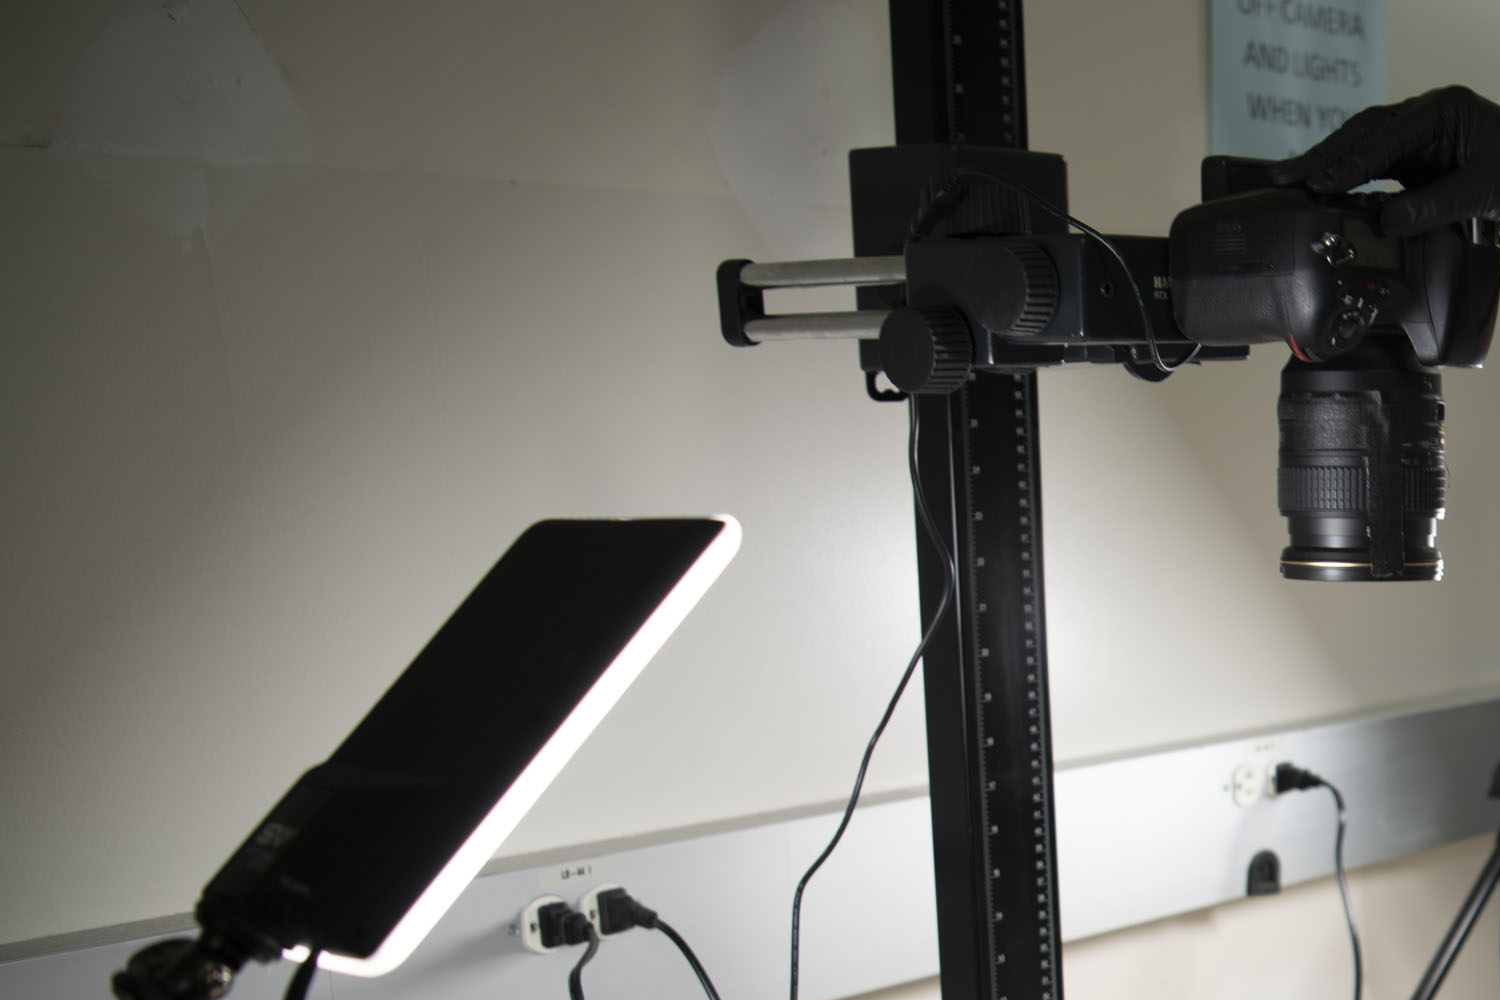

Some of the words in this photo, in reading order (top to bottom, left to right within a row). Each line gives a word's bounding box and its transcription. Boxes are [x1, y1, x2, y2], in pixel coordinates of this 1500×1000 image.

[1279, 0, 1367, 41] CAMERA
[1243, 40, 1289, 75] AND
[1293, 50, 1363, 89] LIGHTS
[1245, 92, 1312, 129] WHEN
